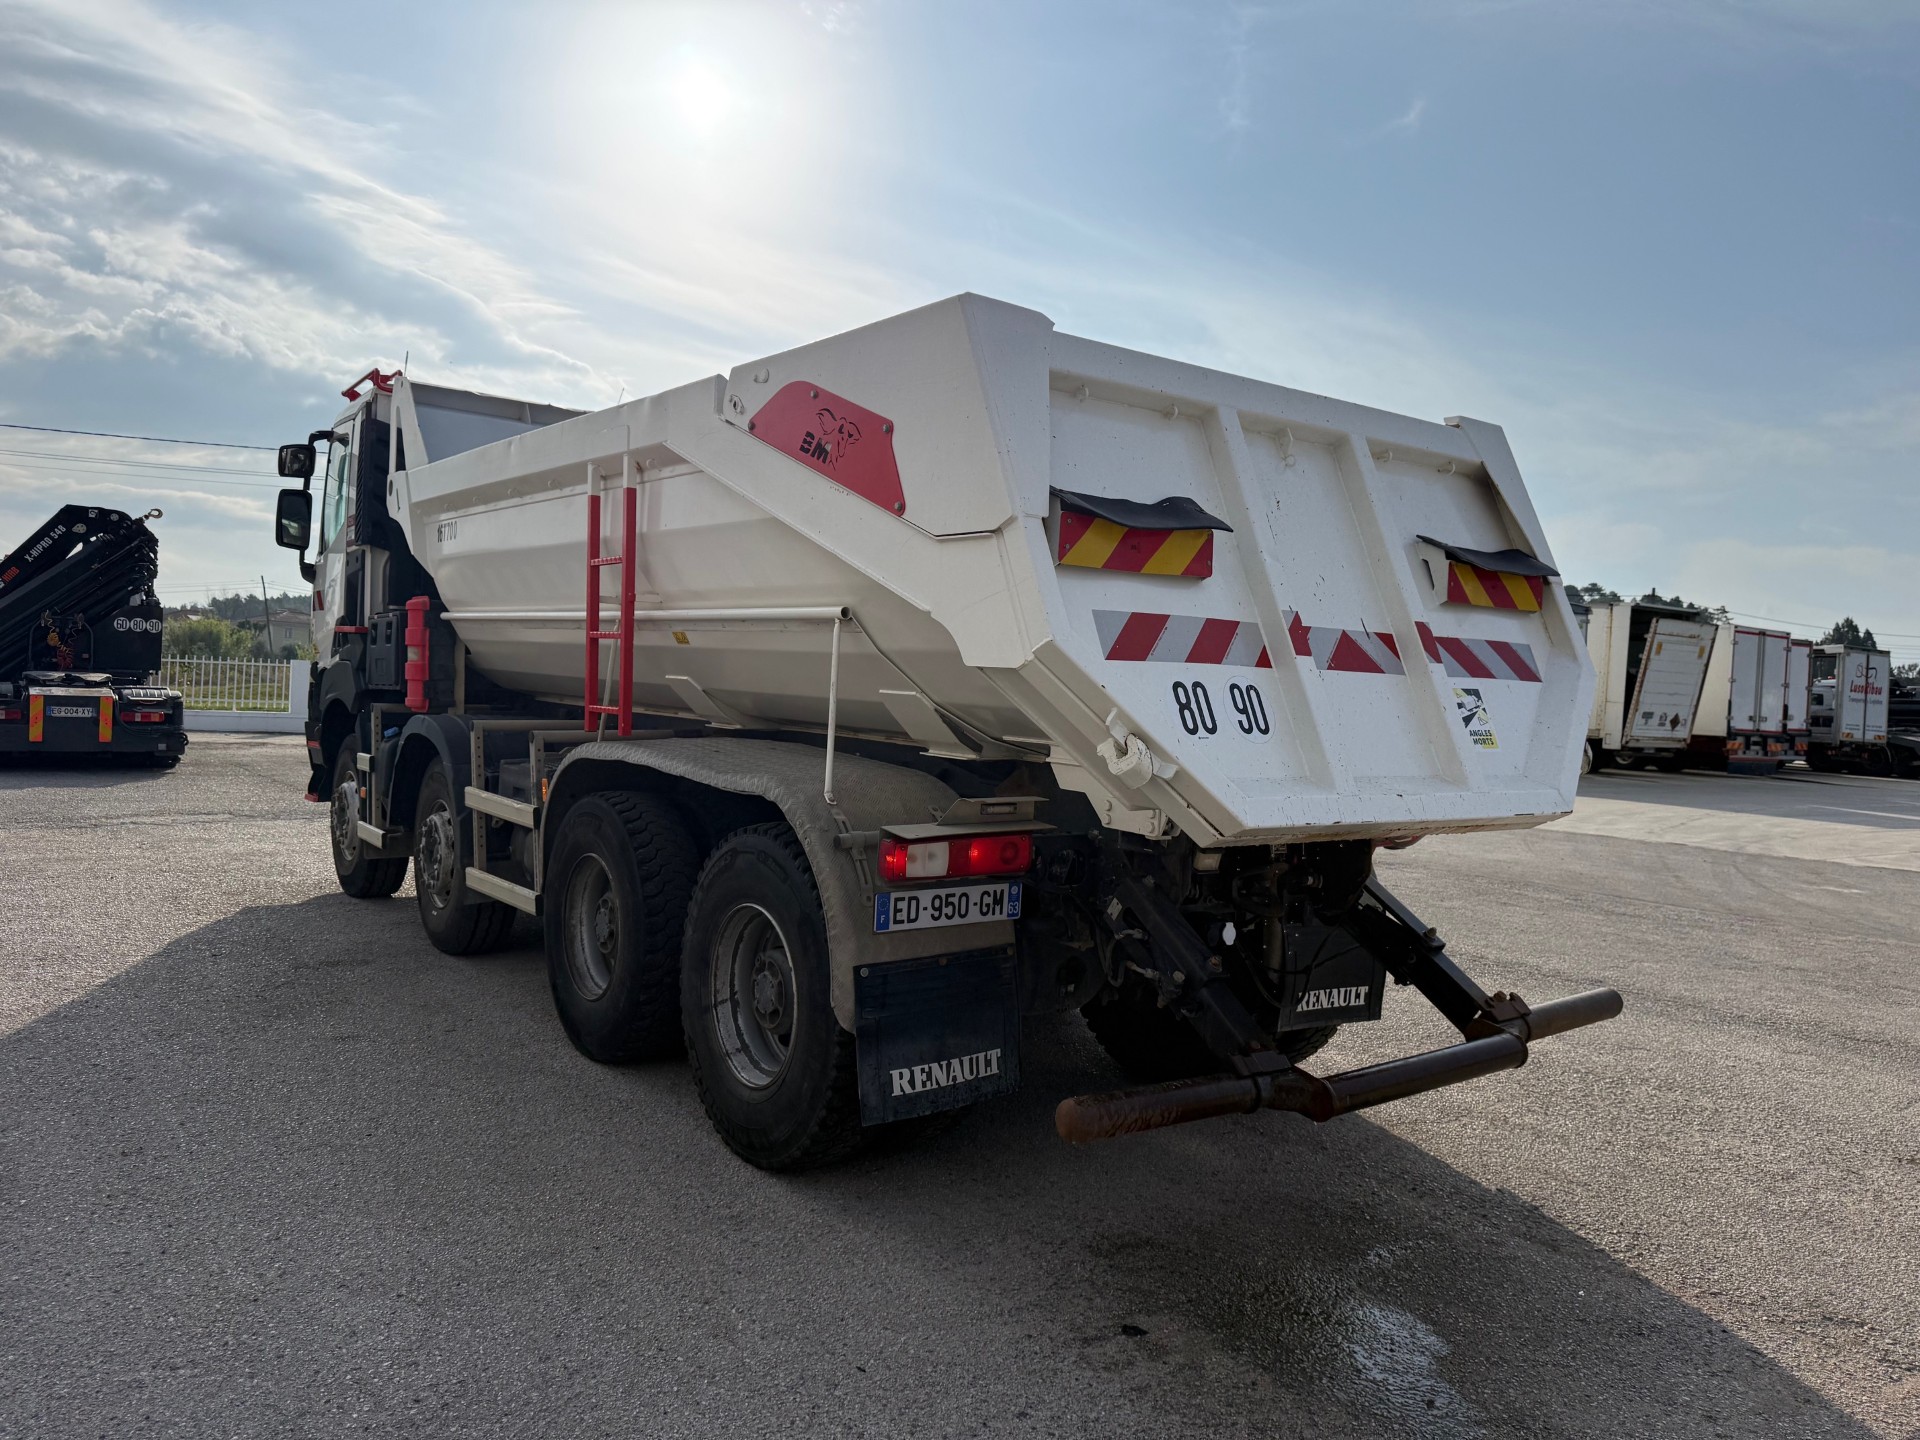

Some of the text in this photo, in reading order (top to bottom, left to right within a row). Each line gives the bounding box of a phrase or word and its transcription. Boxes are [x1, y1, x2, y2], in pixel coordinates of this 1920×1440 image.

[799, 430, 830, 464] BM
[24, 524, 67, 562] X-HIPRO 548
[116, 618, 160, 632] 60 80 90
[1172, 681, 1270, 735] 80 90
[1469, 729, 1493, 737] ANGLES
[1472, 737, 1494, 746] MORTS
[892, 889, 1005, 925] ED-950-GM
[1008, 901, 1019, 914] 63
[889, 1048, 1001, 1097] RENAULT
